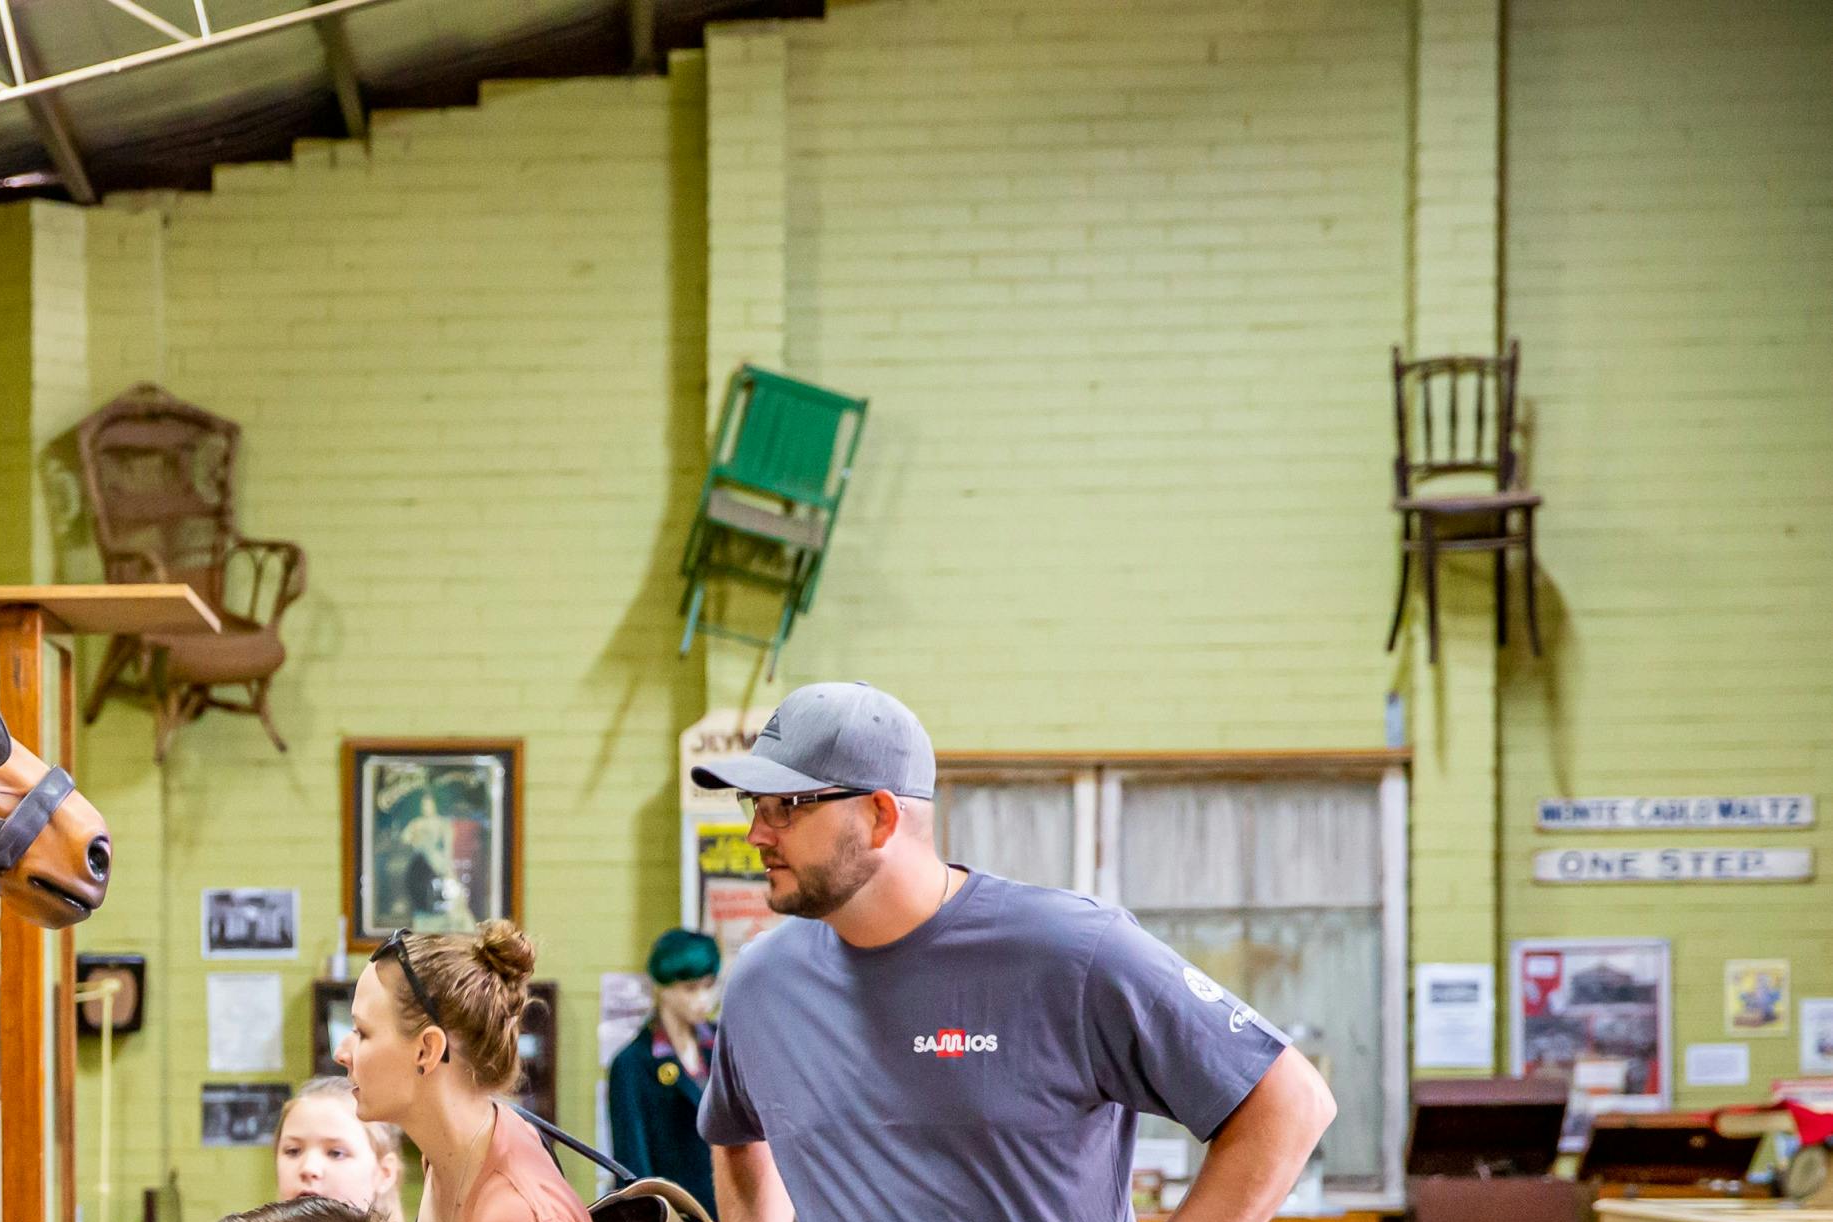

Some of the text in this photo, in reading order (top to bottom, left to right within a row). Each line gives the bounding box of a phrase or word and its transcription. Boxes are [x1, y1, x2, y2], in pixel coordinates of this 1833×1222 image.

[1541, 796, 1801, 825] MONTE CARLO WALTZ
[1558, 848, 1764, 879] ONE STEP
[913, 1033, 998, 1054] SAMIOS
